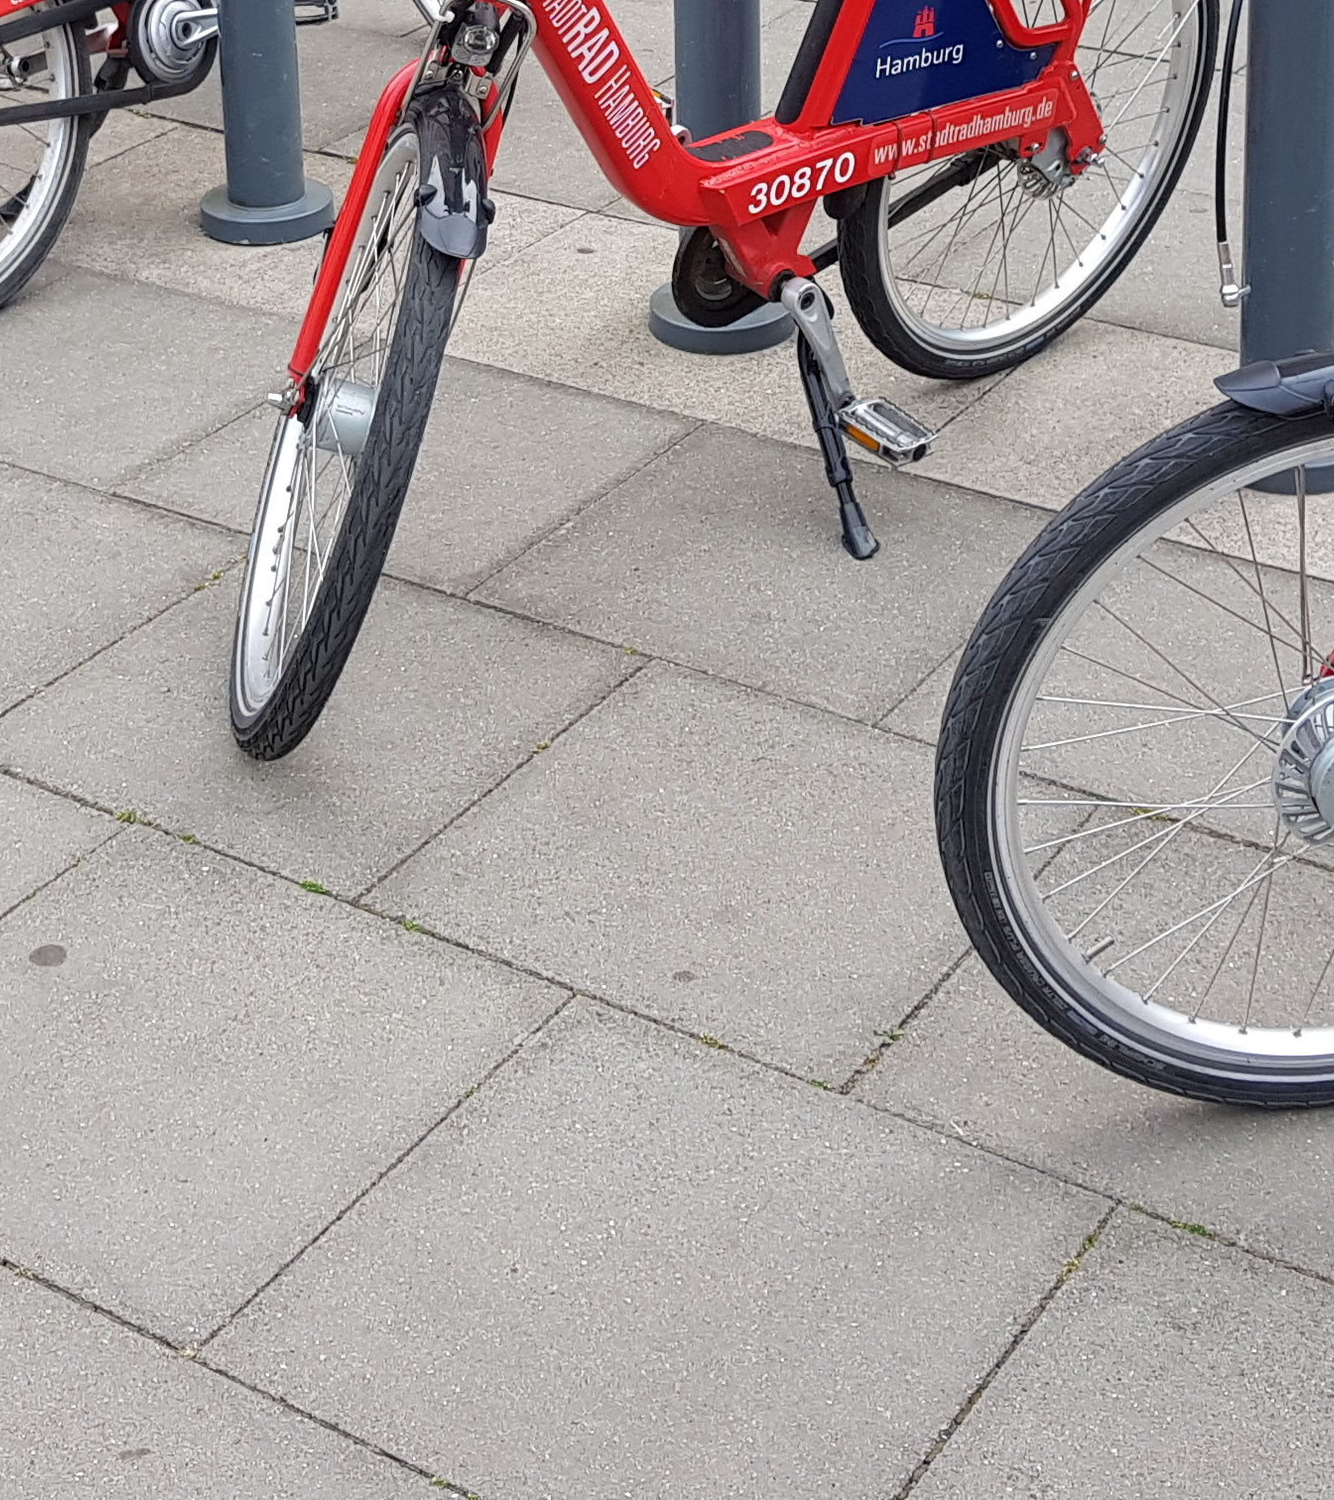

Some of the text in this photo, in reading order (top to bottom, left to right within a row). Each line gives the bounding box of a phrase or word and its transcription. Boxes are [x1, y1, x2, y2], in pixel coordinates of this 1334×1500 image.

[875, 44, 964, 78] Hamburg
[594, 64, 661, 170] HAMBURG
[748, 151, 856, 214] 30870
